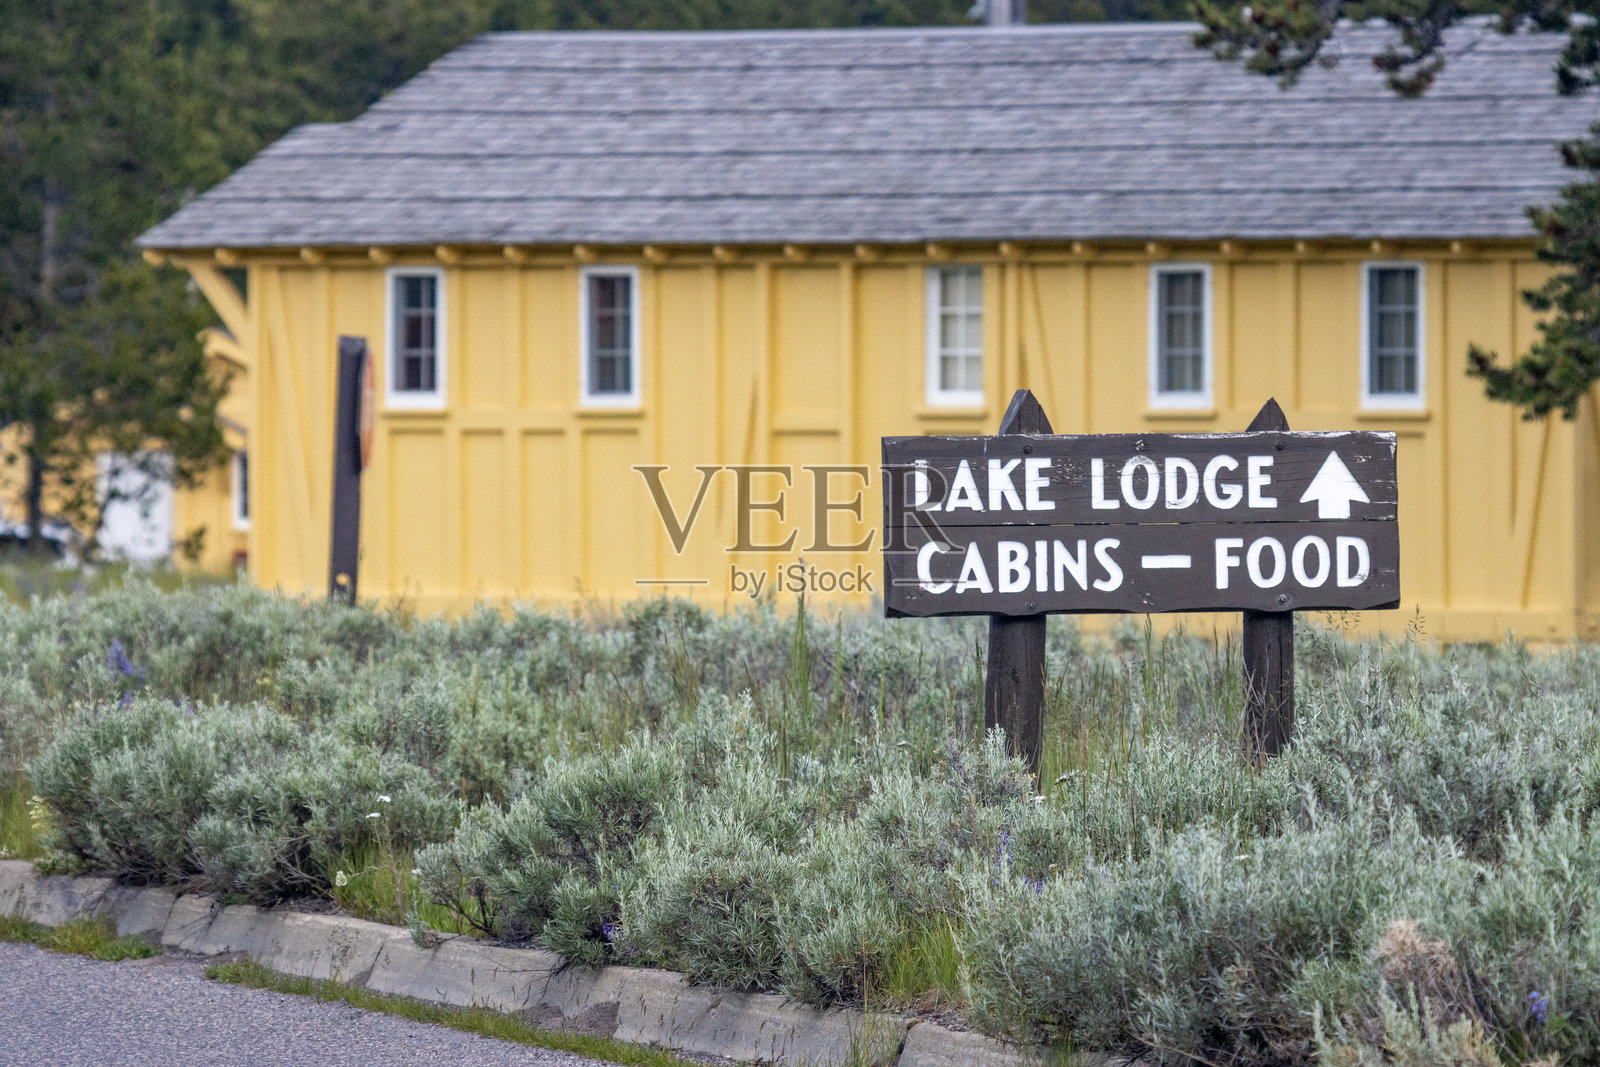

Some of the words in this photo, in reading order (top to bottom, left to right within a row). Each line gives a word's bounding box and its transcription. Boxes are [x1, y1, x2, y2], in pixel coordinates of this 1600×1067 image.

[914, 457, 1055, 512] LAKE
[1091, 454, 1278, 511] LODGE
[916, 538, 1125, 594] CABINS
[1214, 535, 1371, 590] FOOD
